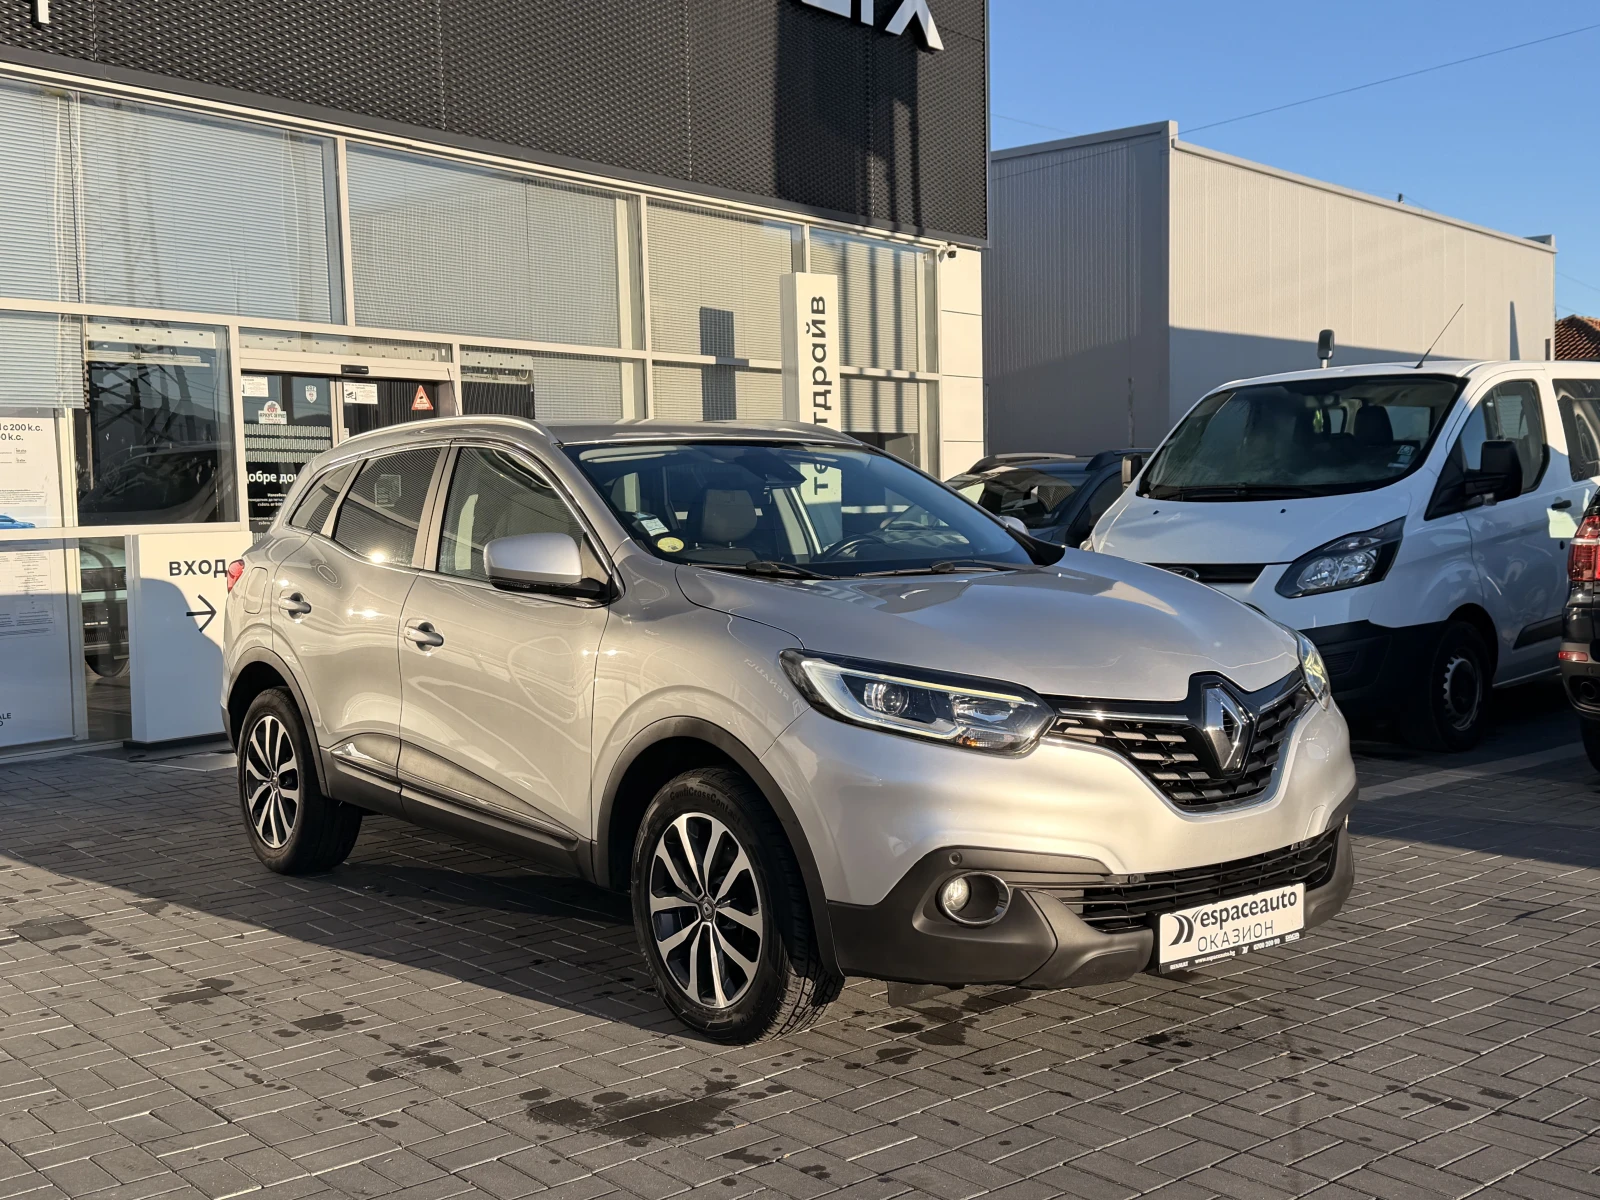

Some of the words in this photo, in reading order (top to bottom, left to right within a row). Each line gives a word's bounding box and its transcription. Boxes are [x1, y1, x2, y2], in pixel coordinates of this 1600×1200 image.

[9, 423, 27, 431] 200
[246, 470, 277, 485] обре
[168, 559, 228, 578] ВХОД
[1200, 890, 1297, 930] espaceauto
[1197, 919, 1274, 952] ОКАЗИОН
